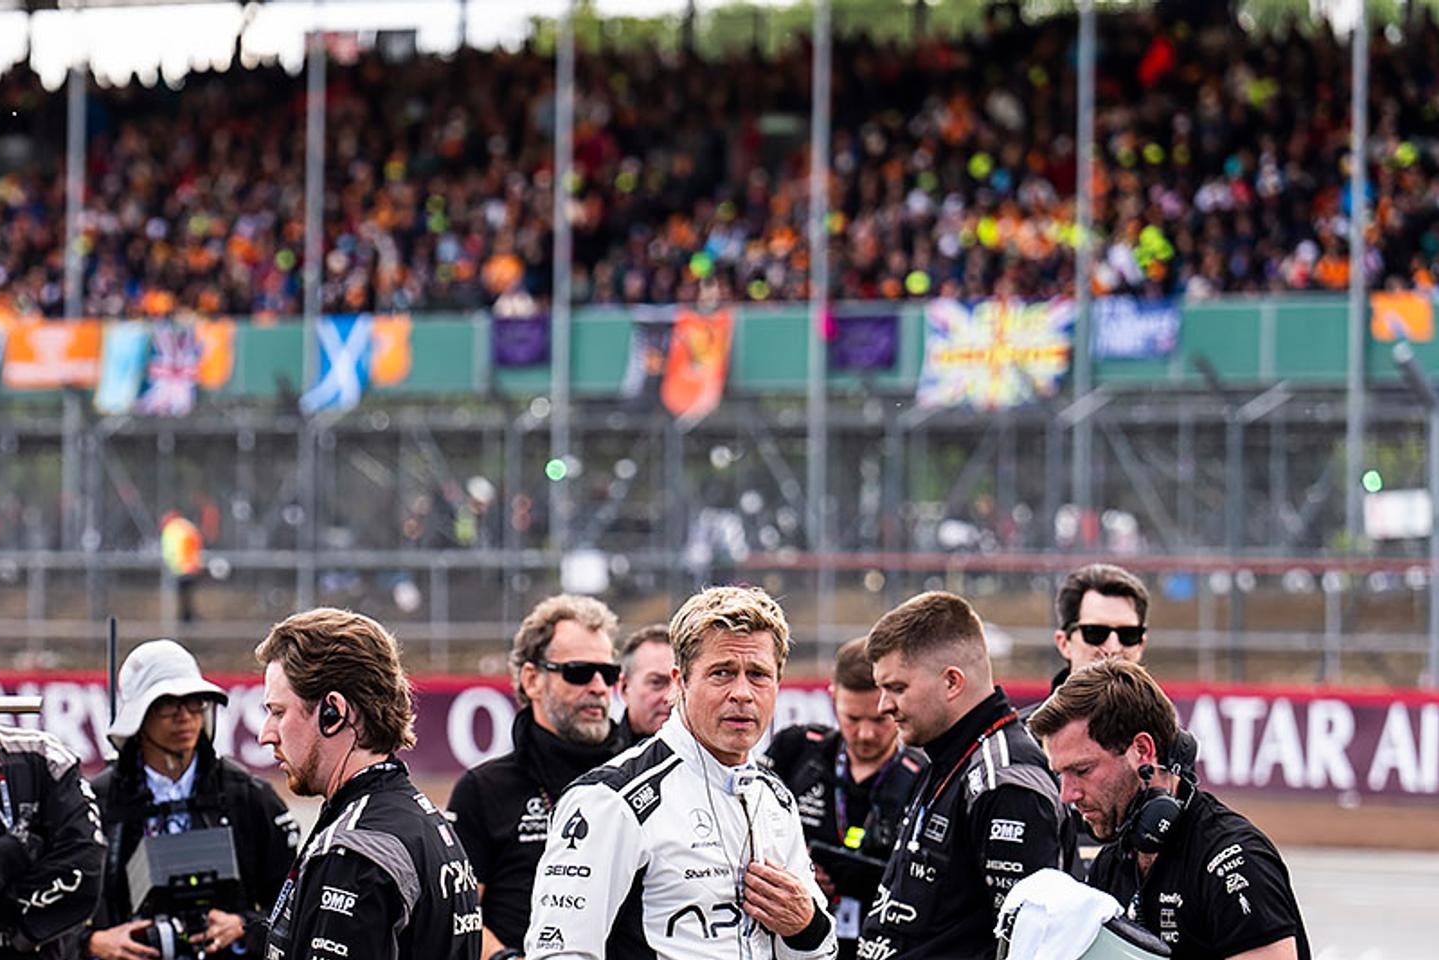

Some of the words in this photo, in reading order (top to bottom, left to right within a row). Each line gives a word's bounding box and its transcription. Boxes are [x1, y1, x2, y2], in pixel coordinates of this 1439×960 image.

[1186, 694, 1357, 789] ATAR
[629, 782, 657, 812] OMP
[989, 821, 1026, 842] OMP
[544, 865, 591, 878] GEICO
[321, 889, 356, 914] OMP
[550, 894, 587, 911] MSC
[538, 926, 565, 943] EA
